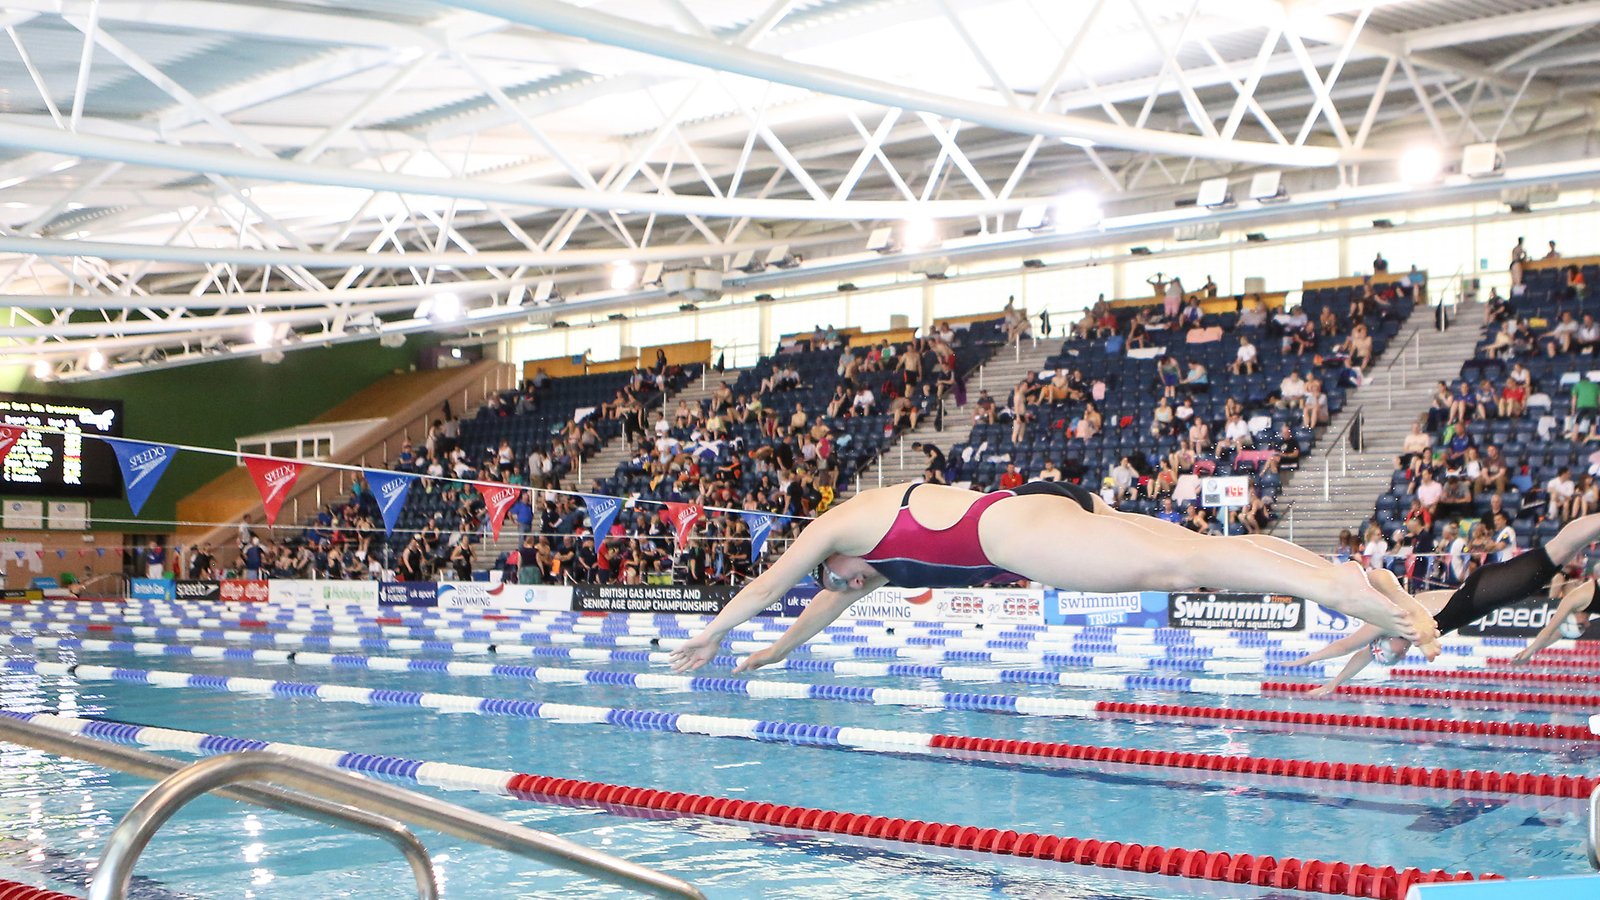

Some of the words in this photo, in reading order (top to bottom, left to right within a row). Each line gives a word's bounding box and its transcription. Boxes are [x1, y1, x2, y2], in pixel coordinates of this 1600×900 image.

[129, 446, 166, 465] SPEEDO
[176, 582, 206, 597] speedo
[332, 586, 360, 603] Holiday
[362, 586, 374, 598] Inn
[419, 590, 436, 600] sport
[456, 585, 484, 594] BRITISH
[600, 588, 628, 598] BRITISH
[629, 589, 643, 598] GAS
[645, 589, 680, 599] MASTERS
[683, 590, 700, 599] AND
[451, 597, 491, 607] SWIMMING
[583, 598, 609, 608] SENIOR
[611, 599, 626, 609] AGE
[627, 600, 652, 610] GROUP
[653, 600, 718, 611] CHAMPIONSHIPS
[788, 596, 799, 606] uk
[951, 596, 984, 613] GBR
[1003, 598, 1040, 616] GBR
[1060, 592, 1139, 610] swimming
[850, 606, 911, 618] SWIMMING
[1174, 595, 1300, 627] Swimming
[1467, 603, 1557, 631] peed
[1088, 612, 1124, 625] TRUST
[1181, 619, 1193, 627] The
[1195, 620, 1232, 629] magazine
[1234, 619, 1245, 628] for
[1247, 619, 1281, 630] aquatics
